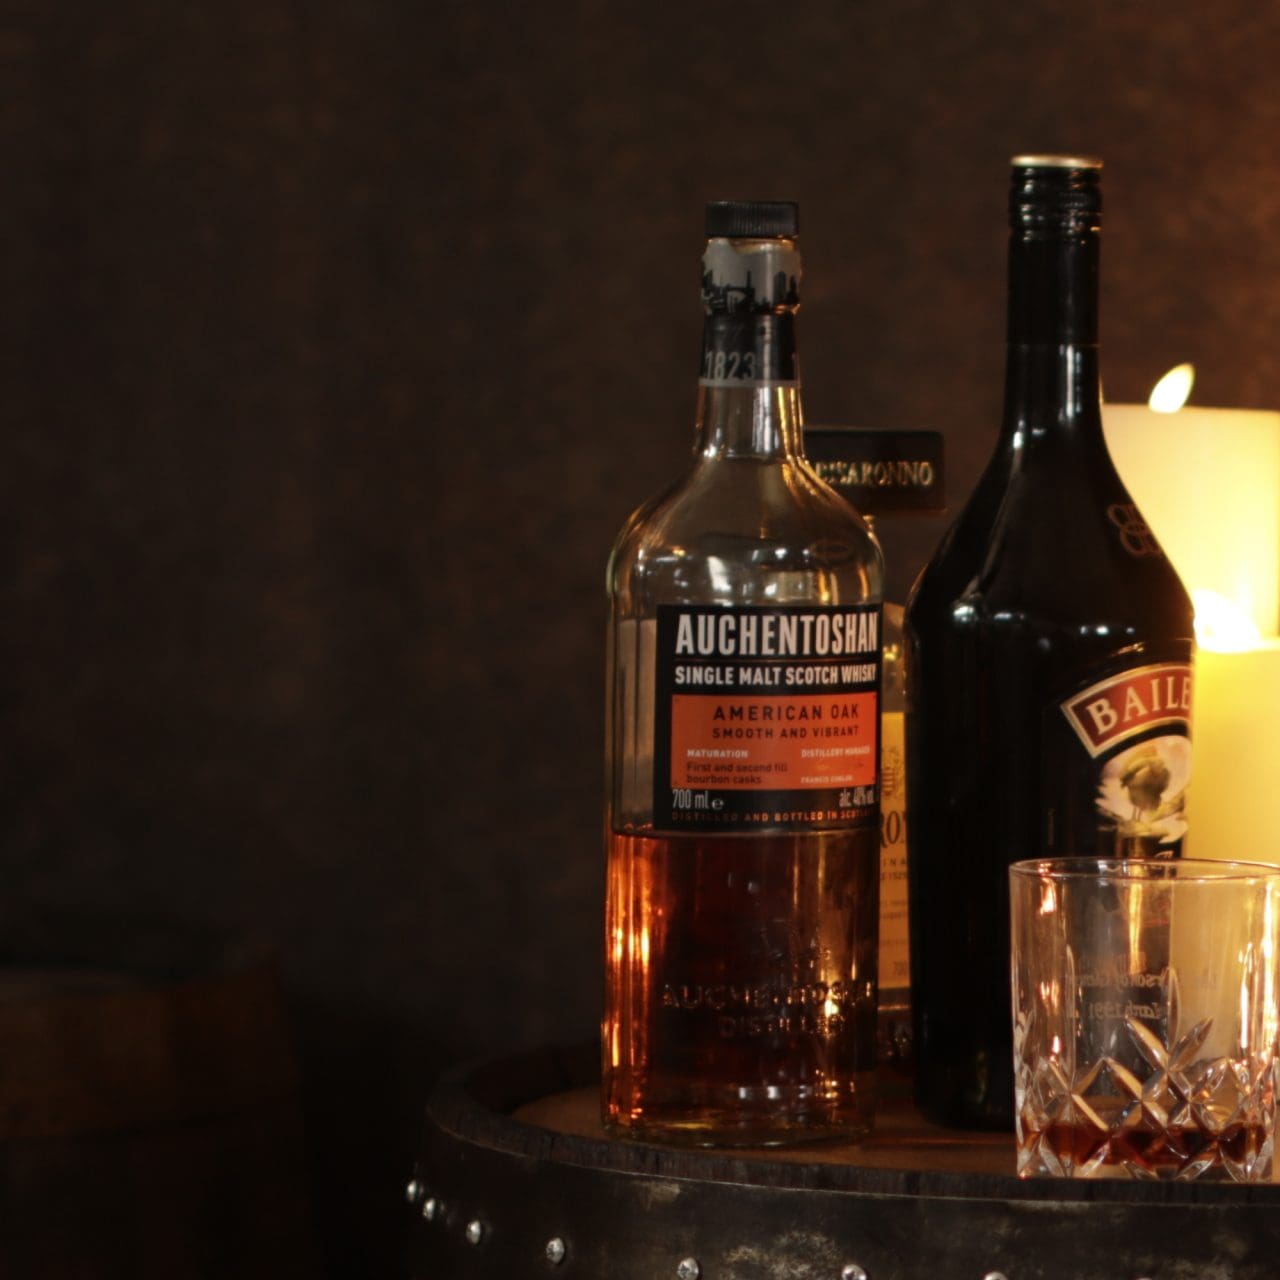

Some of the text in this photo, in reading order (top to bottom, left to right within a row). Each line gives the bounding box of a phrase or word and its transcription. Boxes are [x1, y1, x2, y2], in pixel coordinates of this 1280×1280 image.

[705, 351, 756, 381] 1823
[675, 612, 879, 656] AUCHENTOSHAN
[675, 663, 877, 686] SINGLE MALT SCOTCH WHISKY
[713, 703, 859, 721] AMERICAN OAK
[712, 725, 859, 739] SMOOTH AND VIBRANT
[672, 788, 693, 809] 700
[694, 789, 709, 809] ml
[774, 811, 823, 822] BOTTLED
